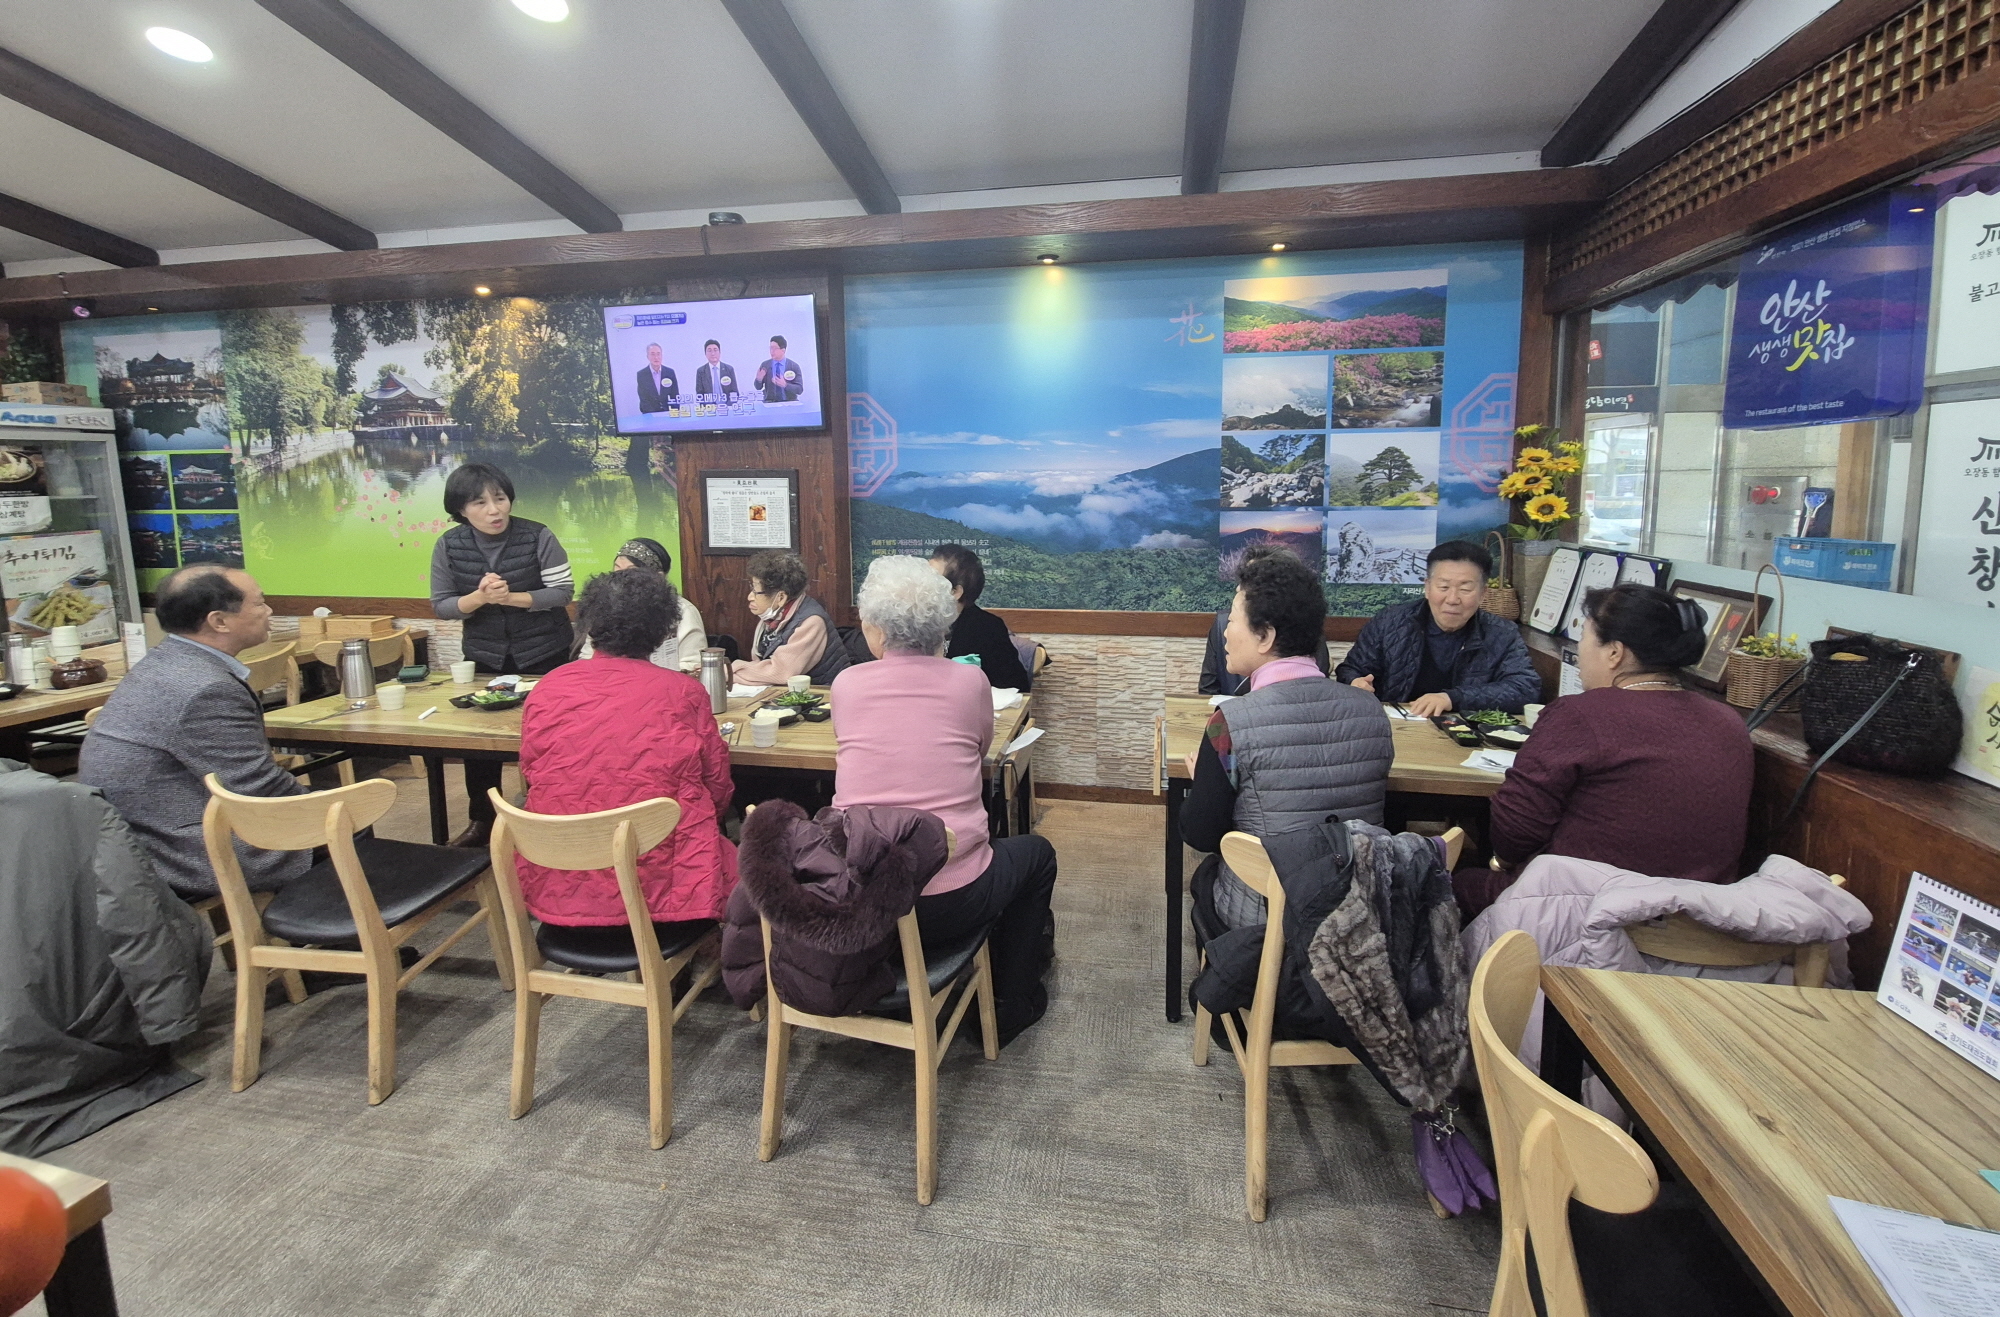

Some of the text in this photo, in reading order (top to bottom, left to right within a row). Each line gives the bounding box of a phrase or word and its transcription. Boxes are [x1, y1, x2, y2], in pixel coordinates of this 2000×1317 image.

[1760, 279, 1832, 334] 안산
[695, 392, 728, 403] 오메가3
[731, 402, 756, 416] 연구
[1745, 400, 1845, 417] The restaurant of the best taste
[1963, 467, 1990, 478] 오장동
[4, 545, 77, 566] 추어튀김
